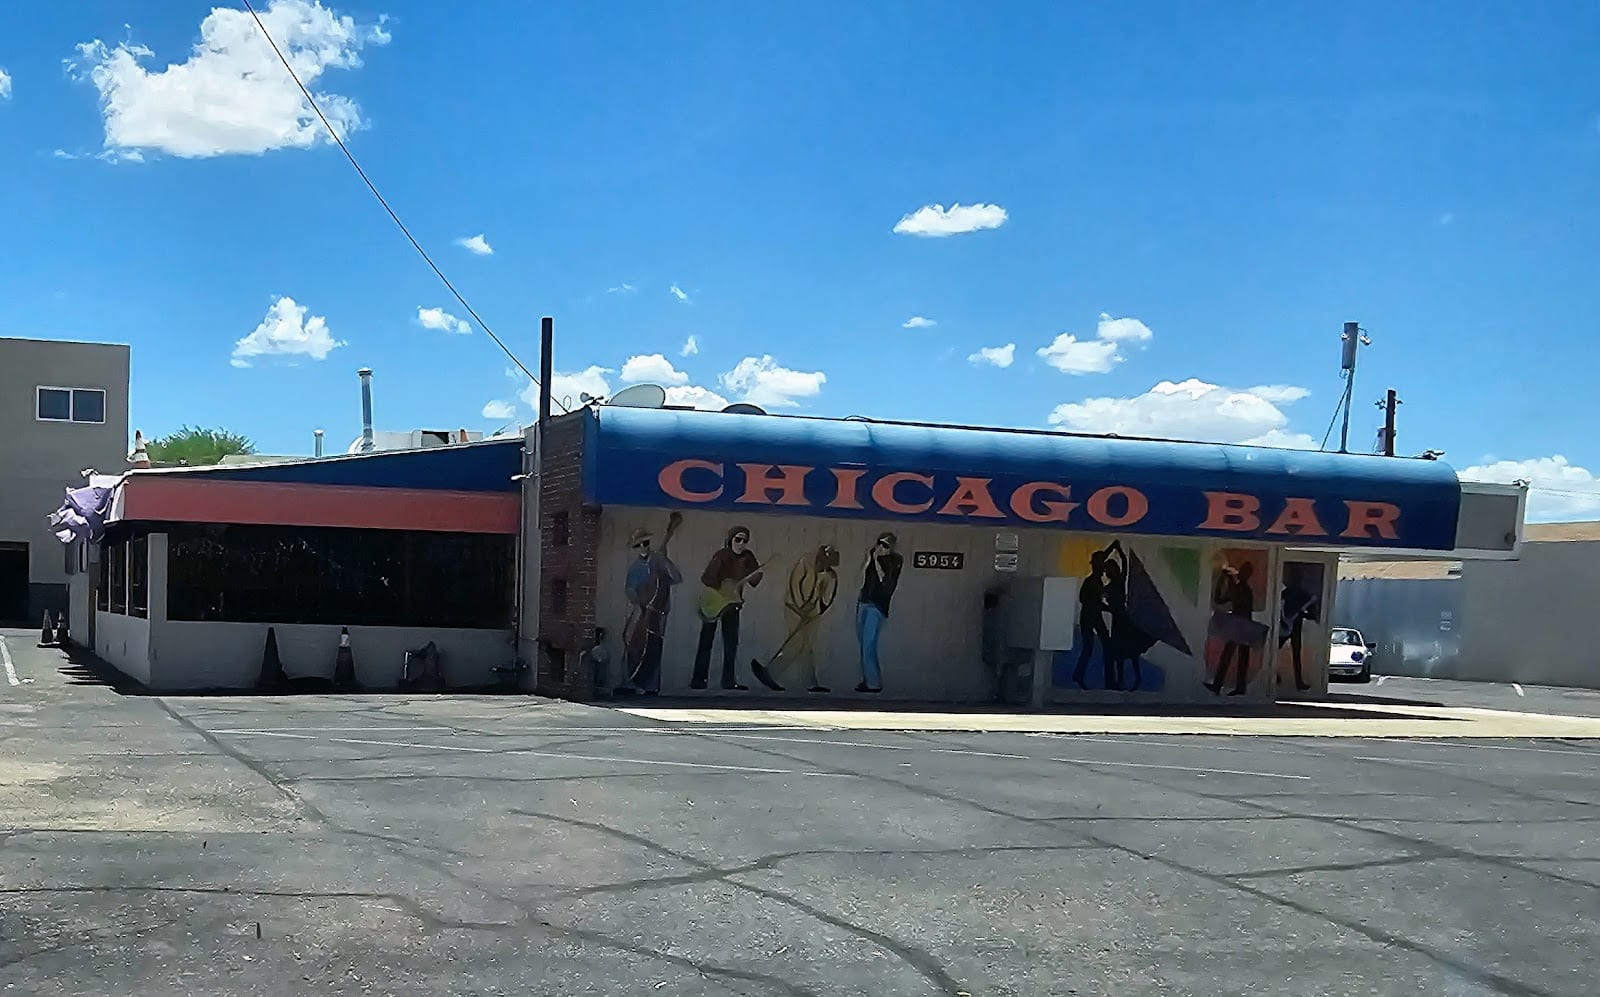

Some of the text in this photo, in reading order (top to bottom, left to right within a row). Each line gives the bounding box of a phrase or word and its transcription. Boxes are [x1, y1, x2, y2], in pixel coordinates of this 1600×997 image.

[658, 460, 1401, 539] CHICAGO BAR
[917, 554, 959, 567] 5954
